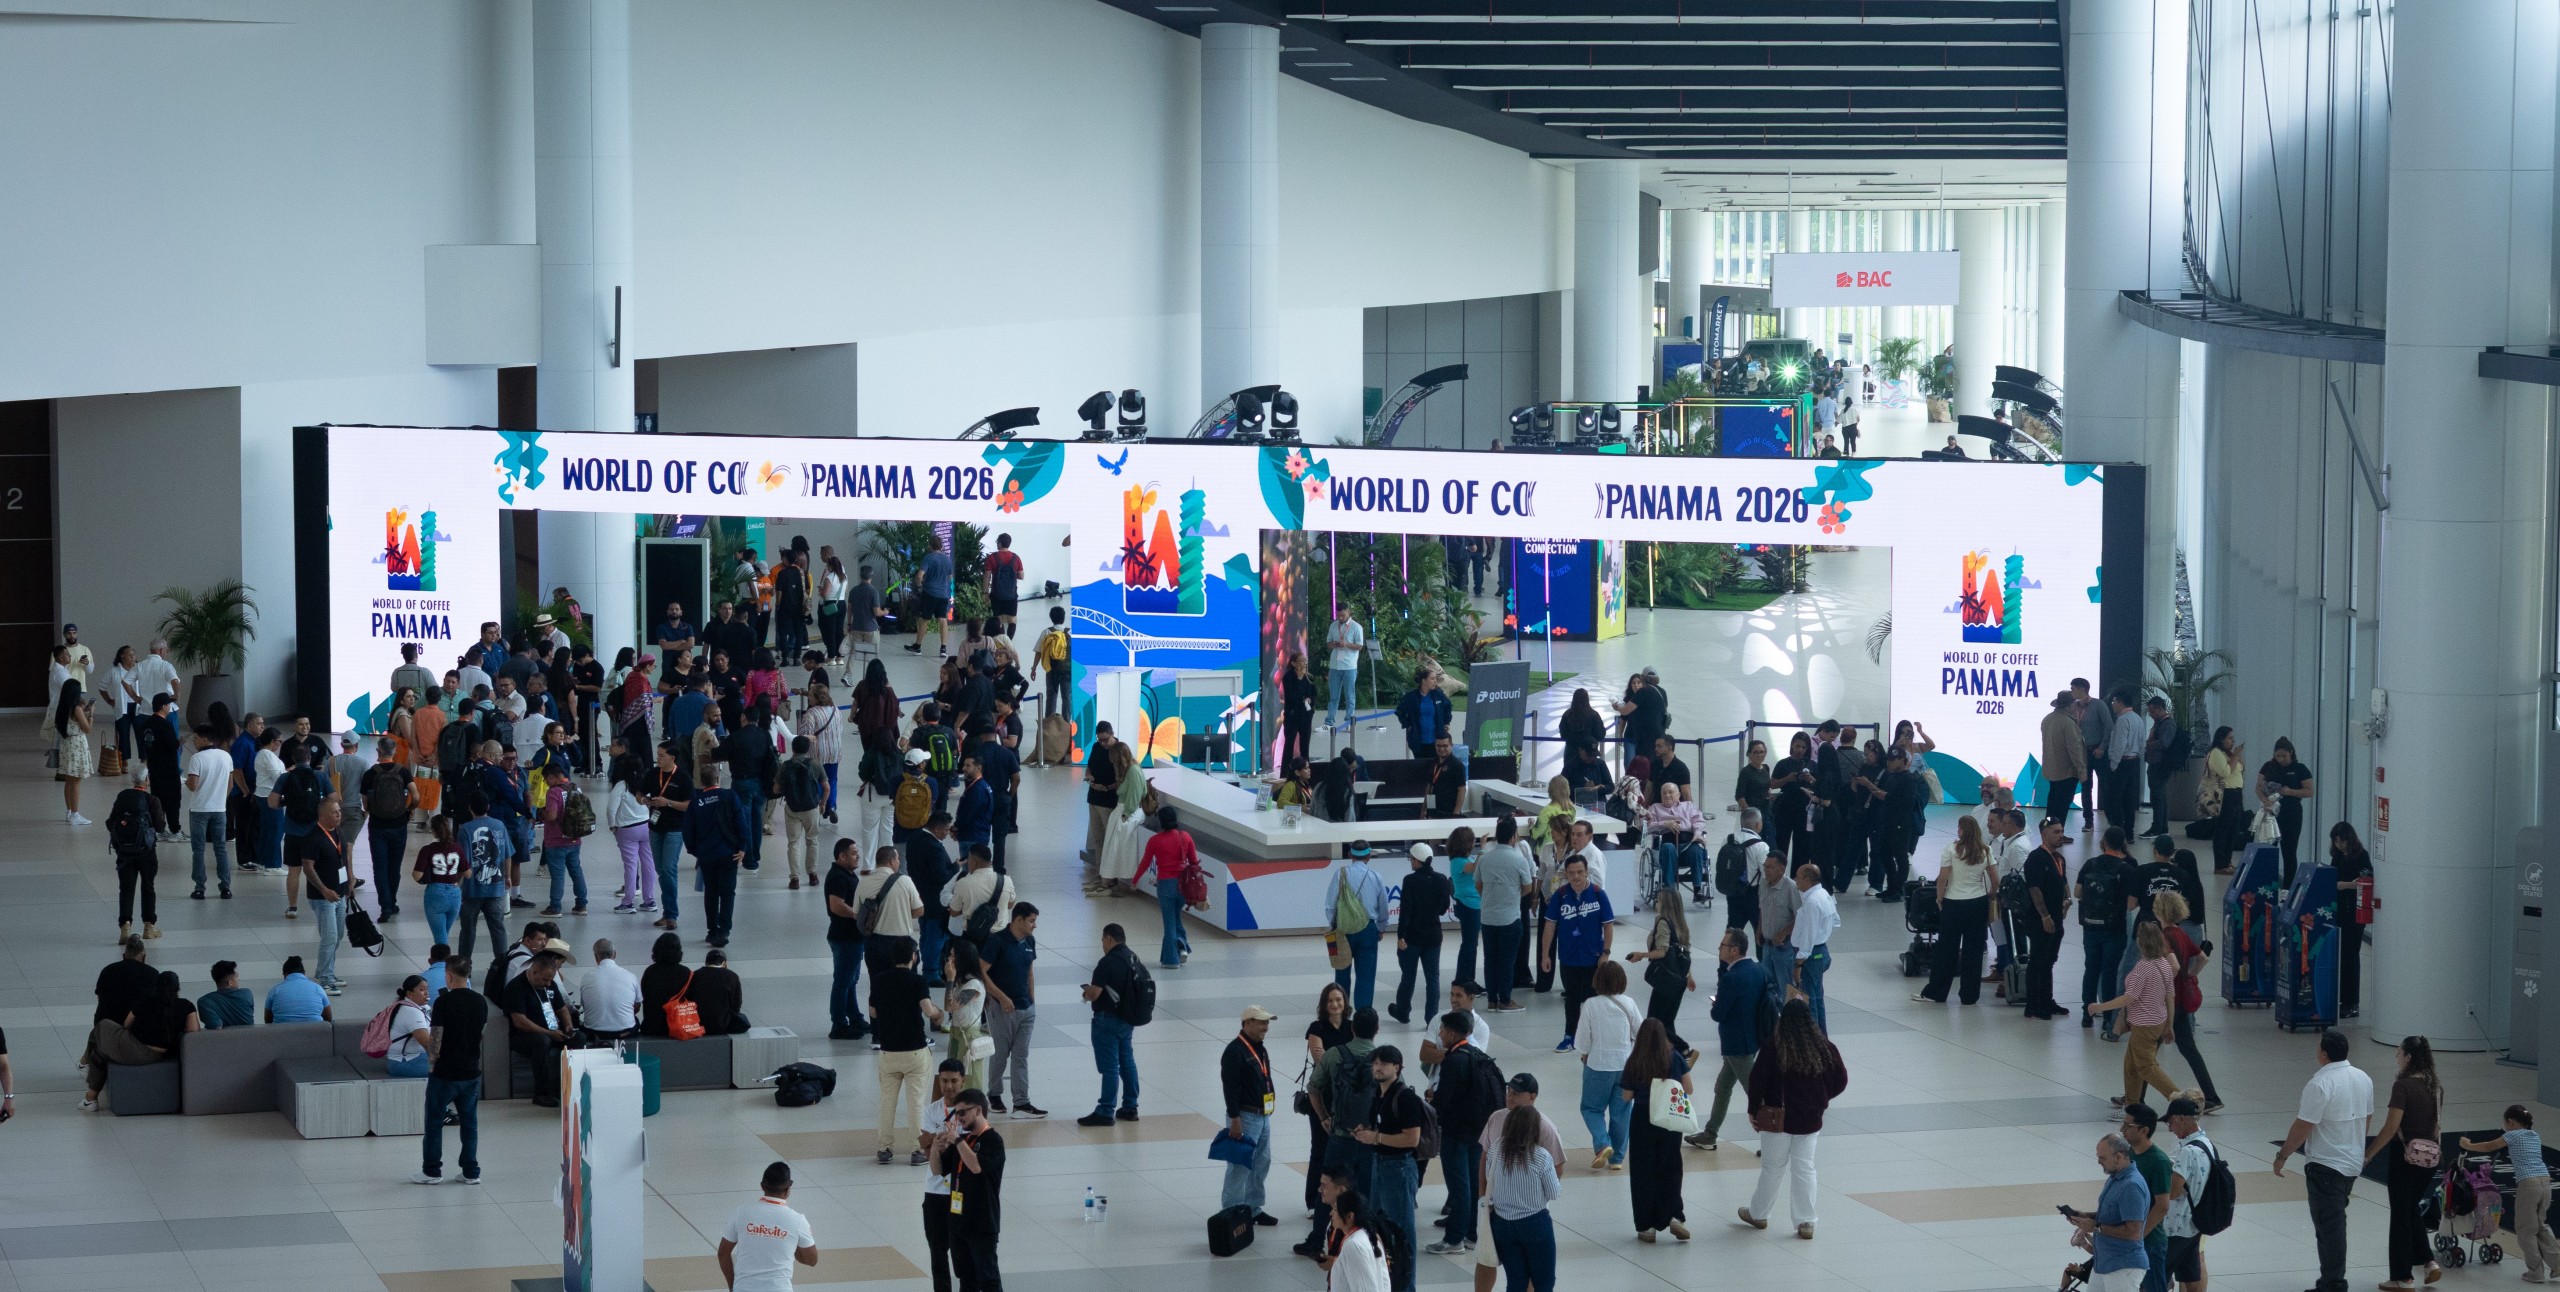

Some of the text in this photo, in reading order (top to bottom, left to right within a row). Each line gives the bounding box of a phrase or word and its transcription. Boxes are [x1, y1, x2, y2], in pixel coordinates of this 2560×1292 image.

[1857, 271, 1892, 288] BAC
[1713, 302, 1723, 359] UTOMARKET
[562, 457, 653, 493] WORLD
[663, 459, 697, 494] OF
[811, 463, 994, 501] PANAMA 2026
[0, 487, 23, 510] 2
[1330, 475, 1430, 513] WORLD
[1442, 479, 1479, 515] OF
[1605, 483, 1809, 524] PANAMA 2026
[1525, 543, 1578, 555] CONNECTION
[372, 598, 451, 611] WORLD OF COFFEE
[371, 612, 452, 641] PANAMA
[1943, 651, 2039, 666] WORLD OF COFFEE
[1942, 667, 2039, 698] PANAMA
[1489, 688, 1521, 703] gotuuri
[1976, 700, 2004, 715] 2026
[1560, 901, 1601, 919] Dodgers
